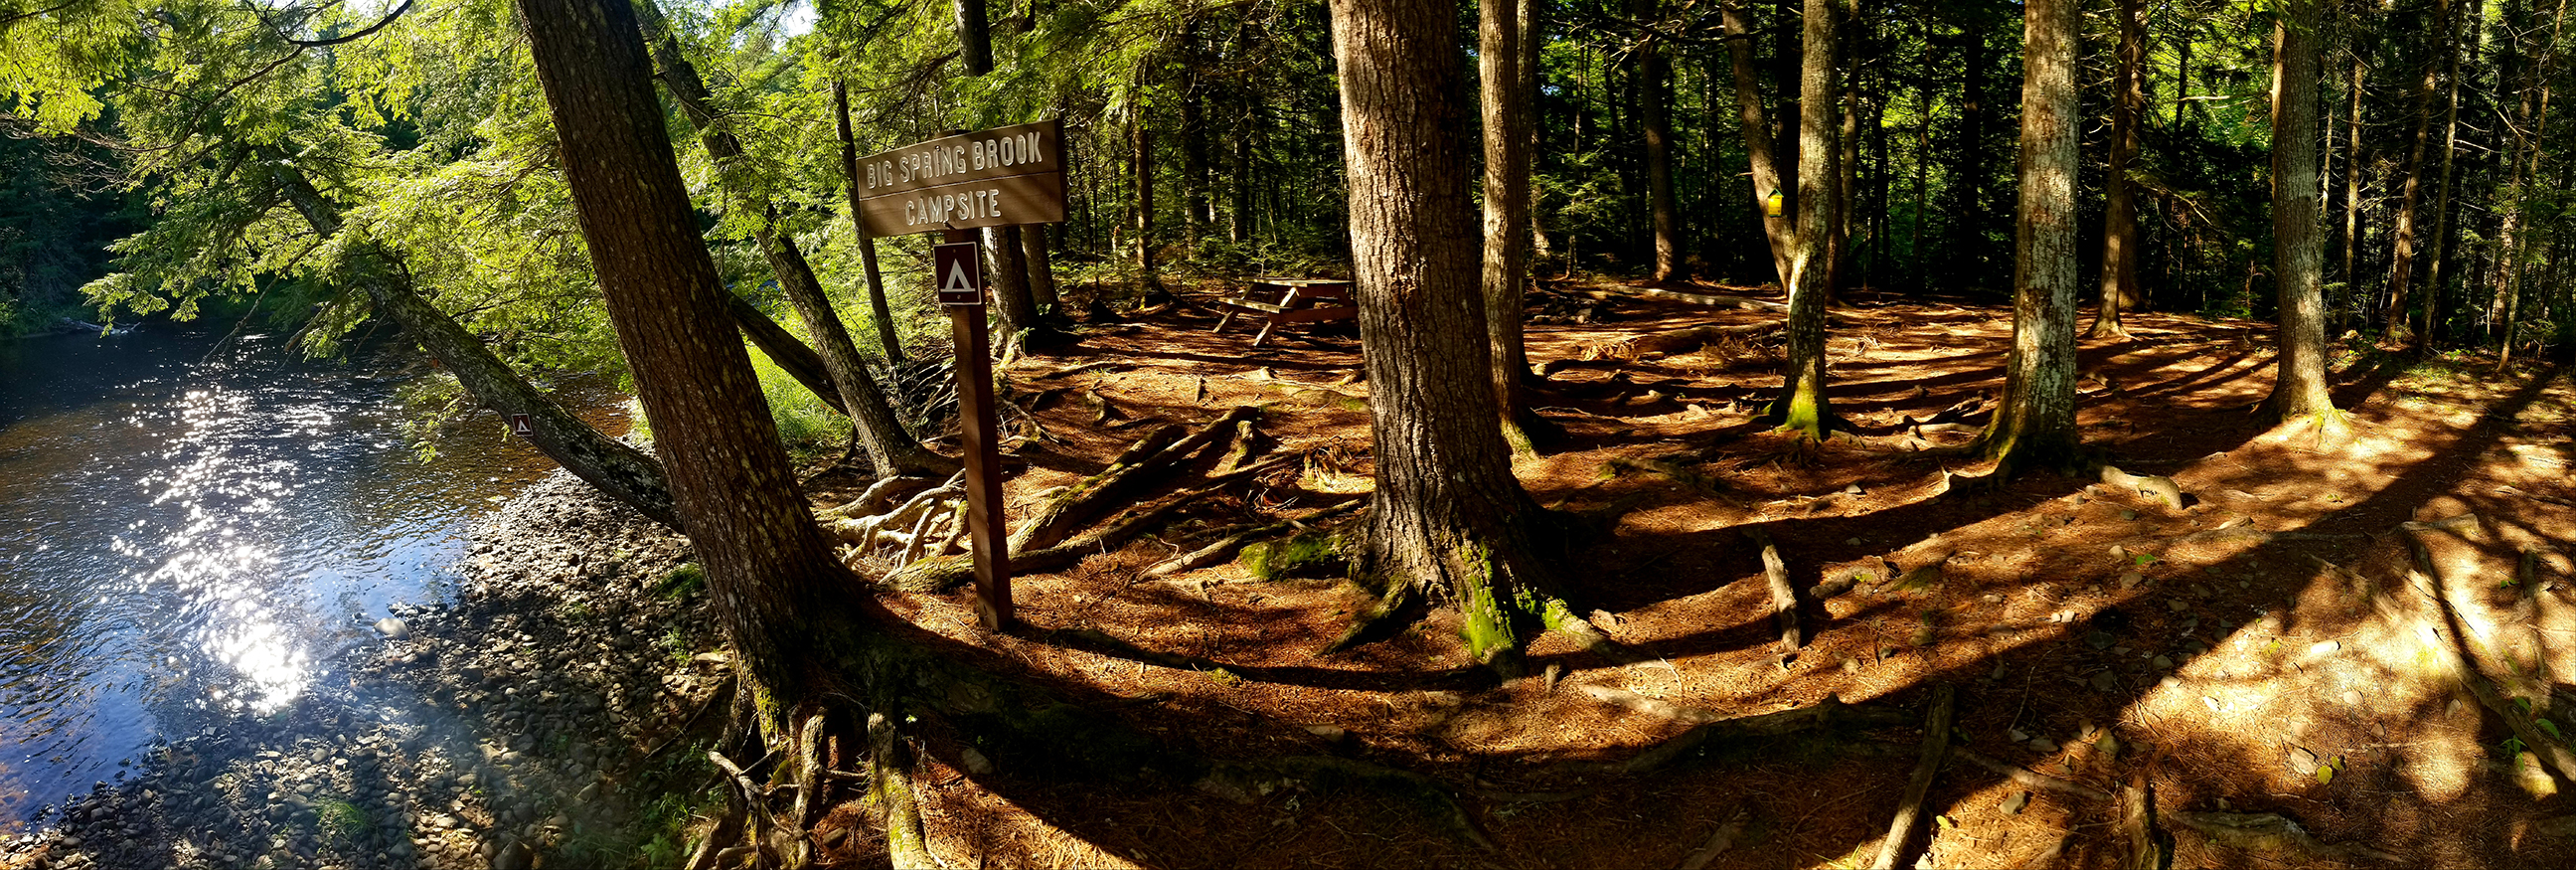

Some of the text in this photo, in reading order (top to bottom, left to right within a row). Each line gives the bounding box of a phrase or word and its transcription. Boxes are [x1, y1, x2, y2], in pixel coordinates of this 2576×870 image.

[867, 131, 1043, 189] BIG SPRING BROOK
[904, 189, 1001, 226] CAMPSITE
